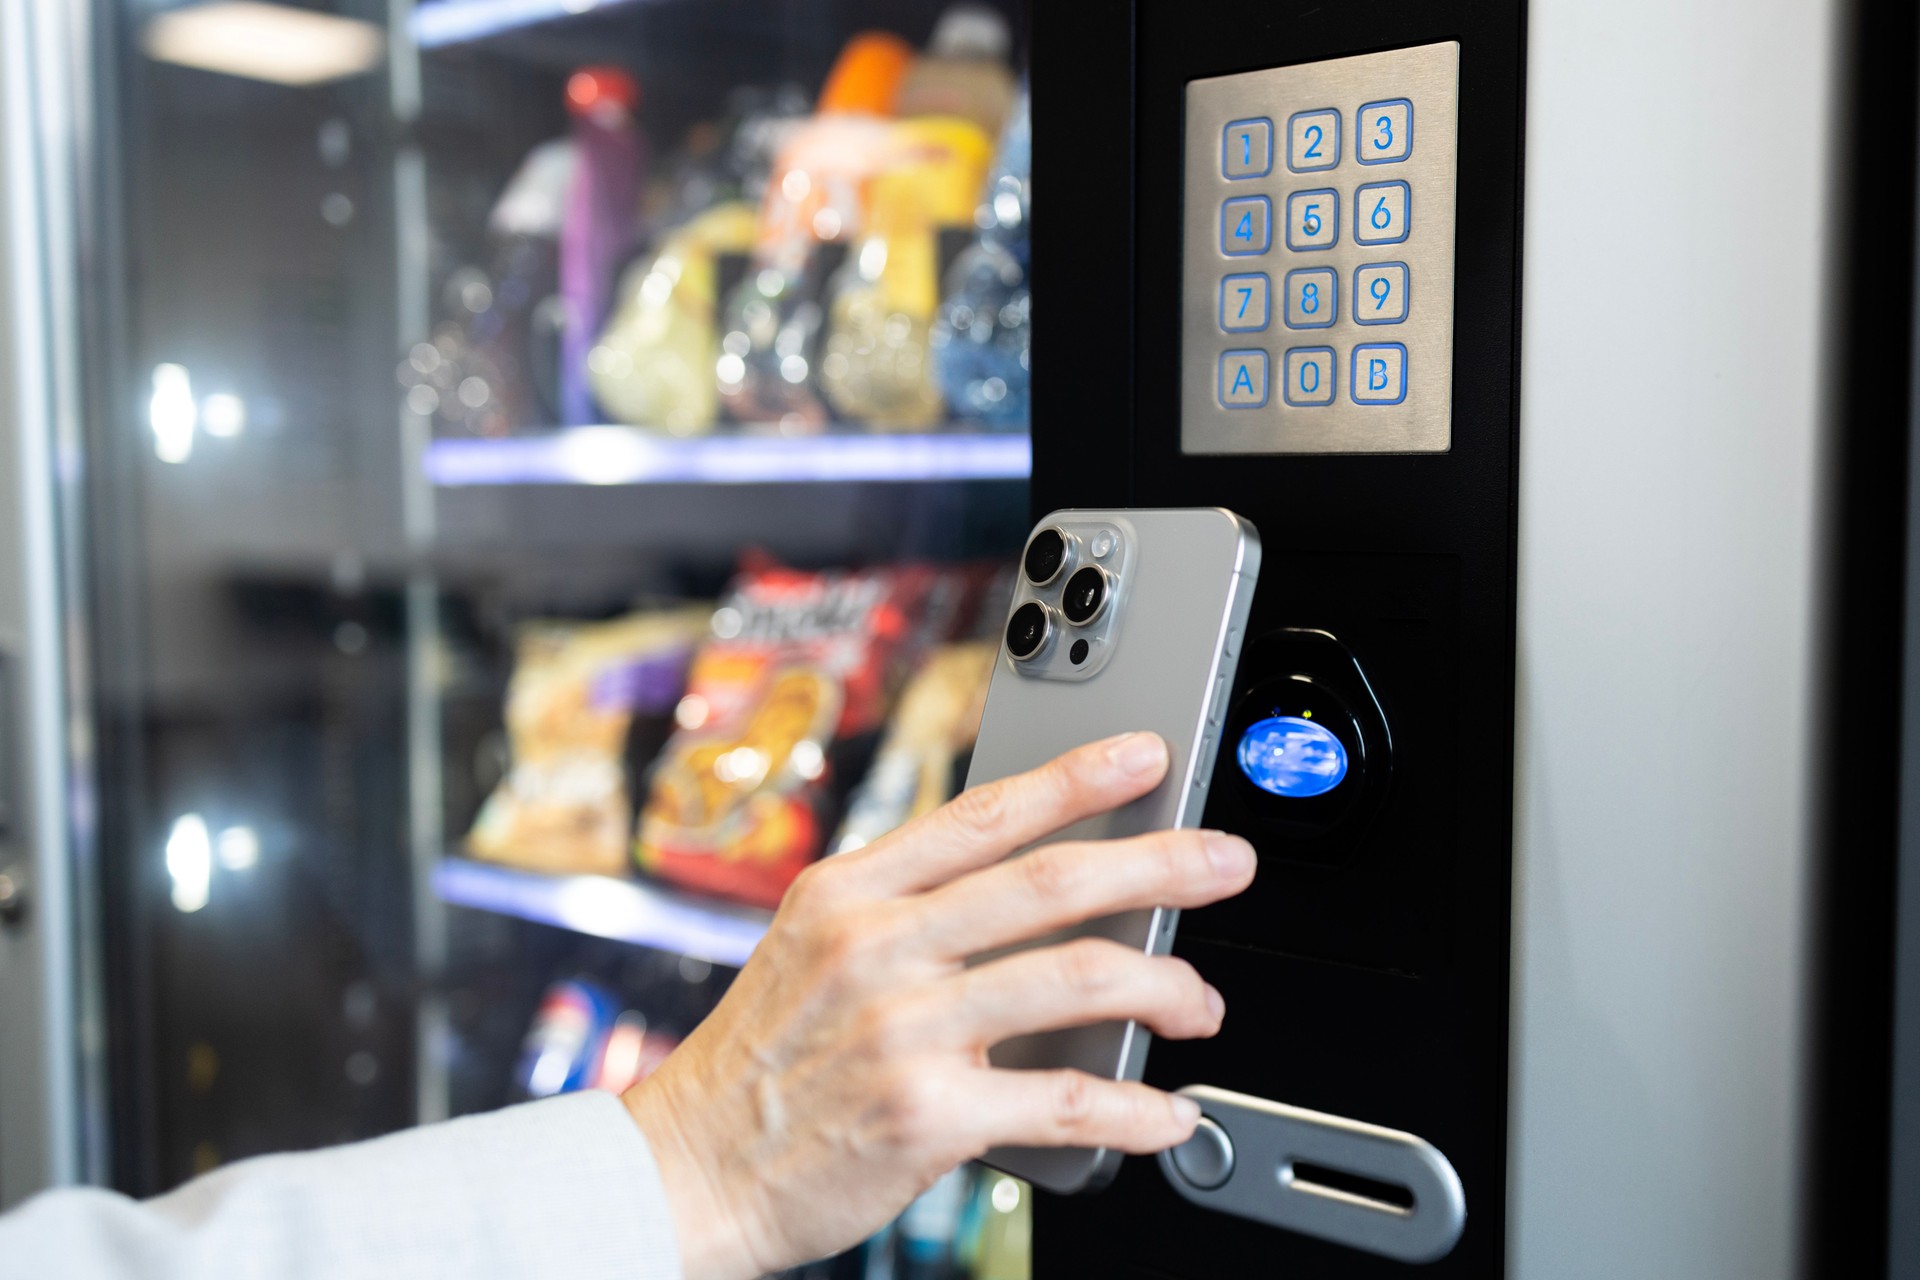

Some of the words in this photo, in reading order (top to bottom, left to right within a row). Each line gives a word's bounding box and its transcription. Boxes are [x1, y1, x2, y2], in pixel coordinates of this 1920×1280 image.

[1240, 134, 1251, 166] 1
[1304, 125, 1323, 159] 2
[1373, 115, 1393, 150] 3
[1234, 211, 1253, 242] 4
[1302, 204, 1322, 237] 5
[1371, 196, 1391, 230] 6
[1237, 288, 1253, 318] 7
[1300, 283, 1319, 314] 8
[1370, 278, 1390, 310] 9
[1232, 365, 1253, 395] A
[1300, 362, 1319, 393] 0
[1369, 359, 1388, 391] B
